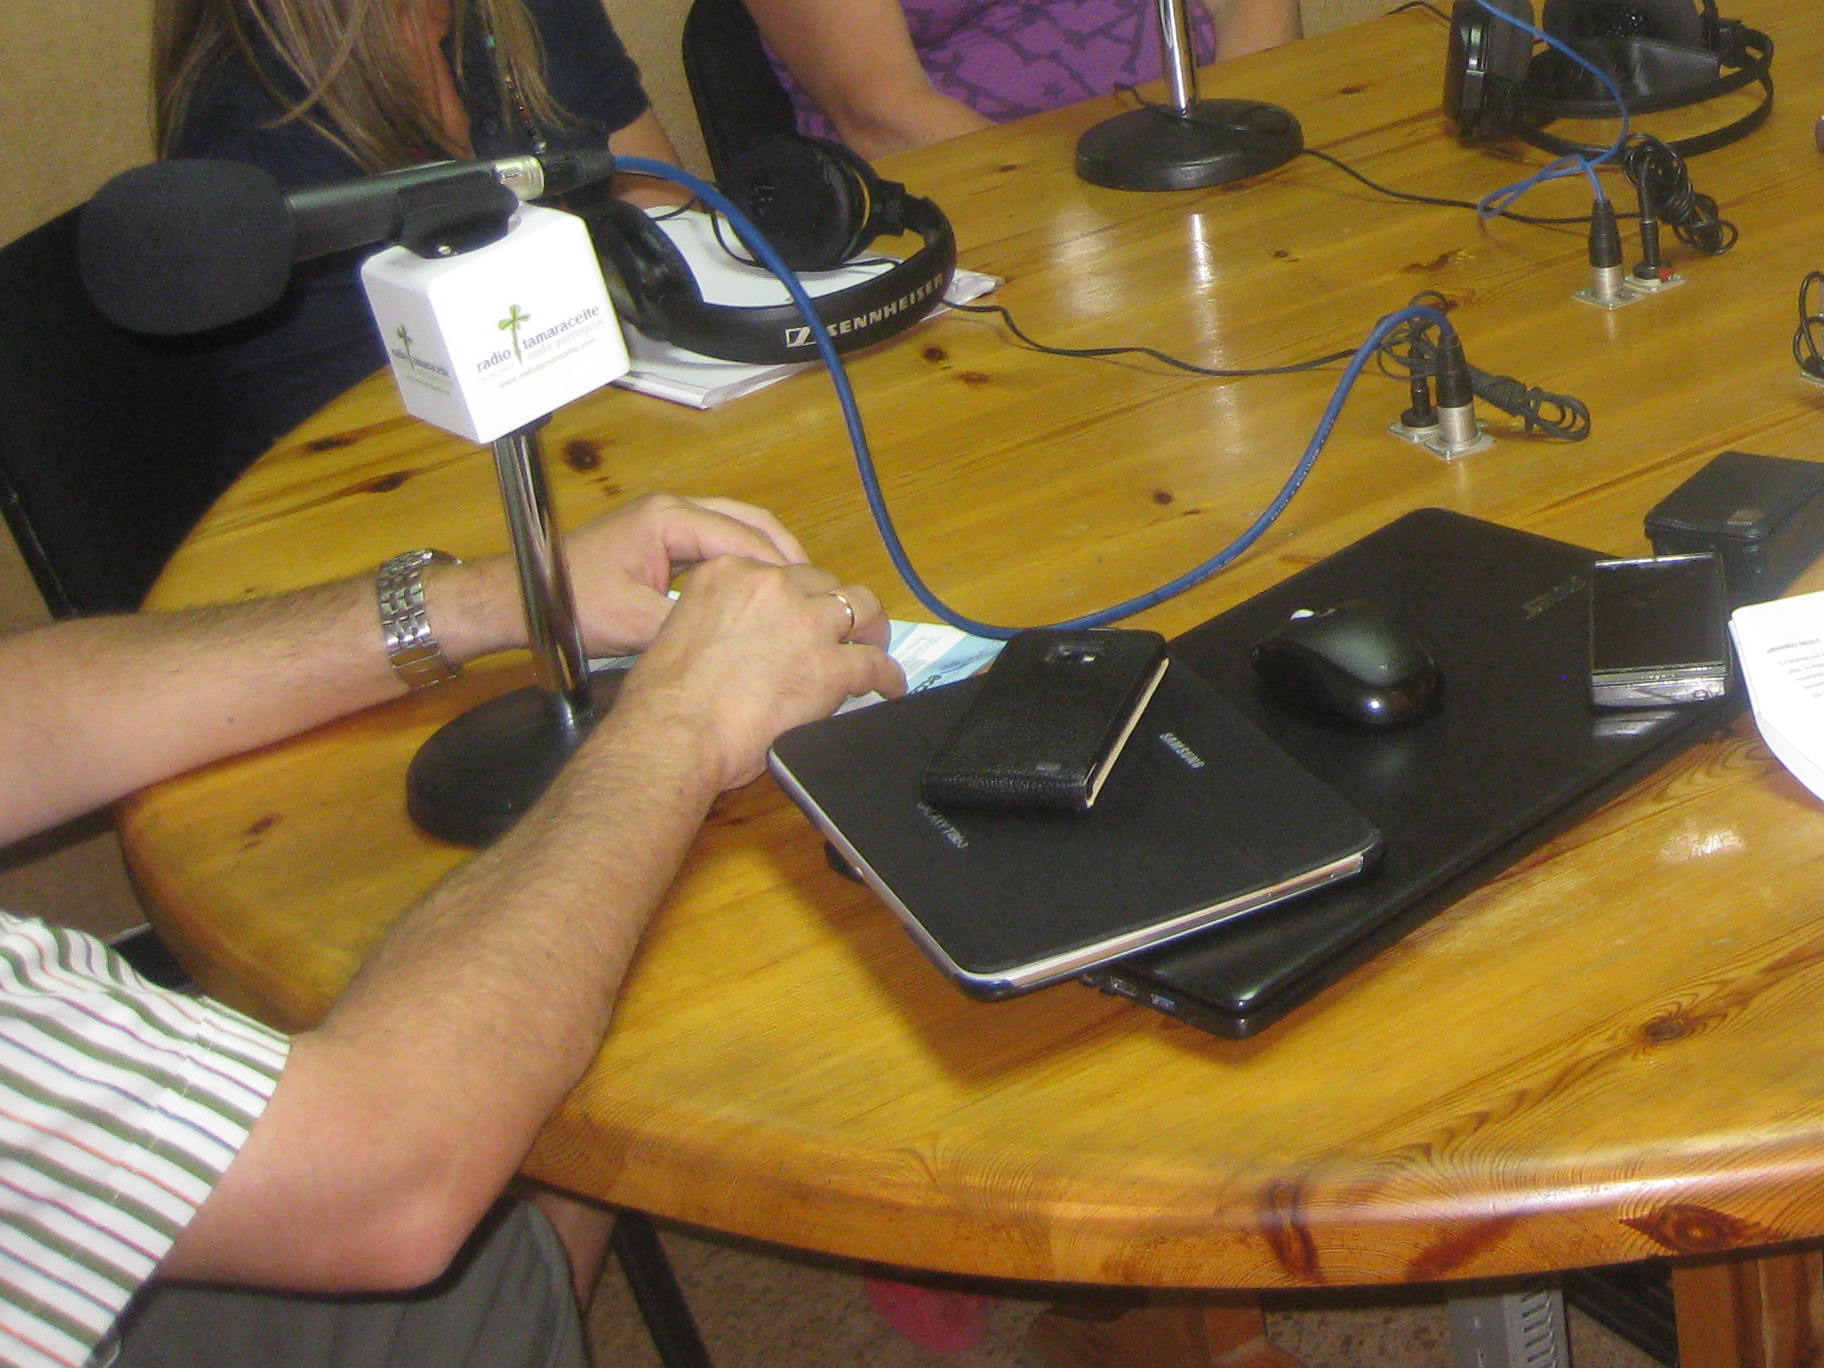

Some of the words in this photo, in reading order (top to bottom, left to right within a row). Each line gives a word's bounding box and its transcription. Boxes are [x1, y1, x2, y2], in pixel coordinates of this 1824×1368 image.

[826, 273, 943, 338] SENNHEISER
[475, 348, 512, 374] radio
[522, 304, 601, 351] tamaraceite
[1159, 732, 1206, 768] SAMSUNG
